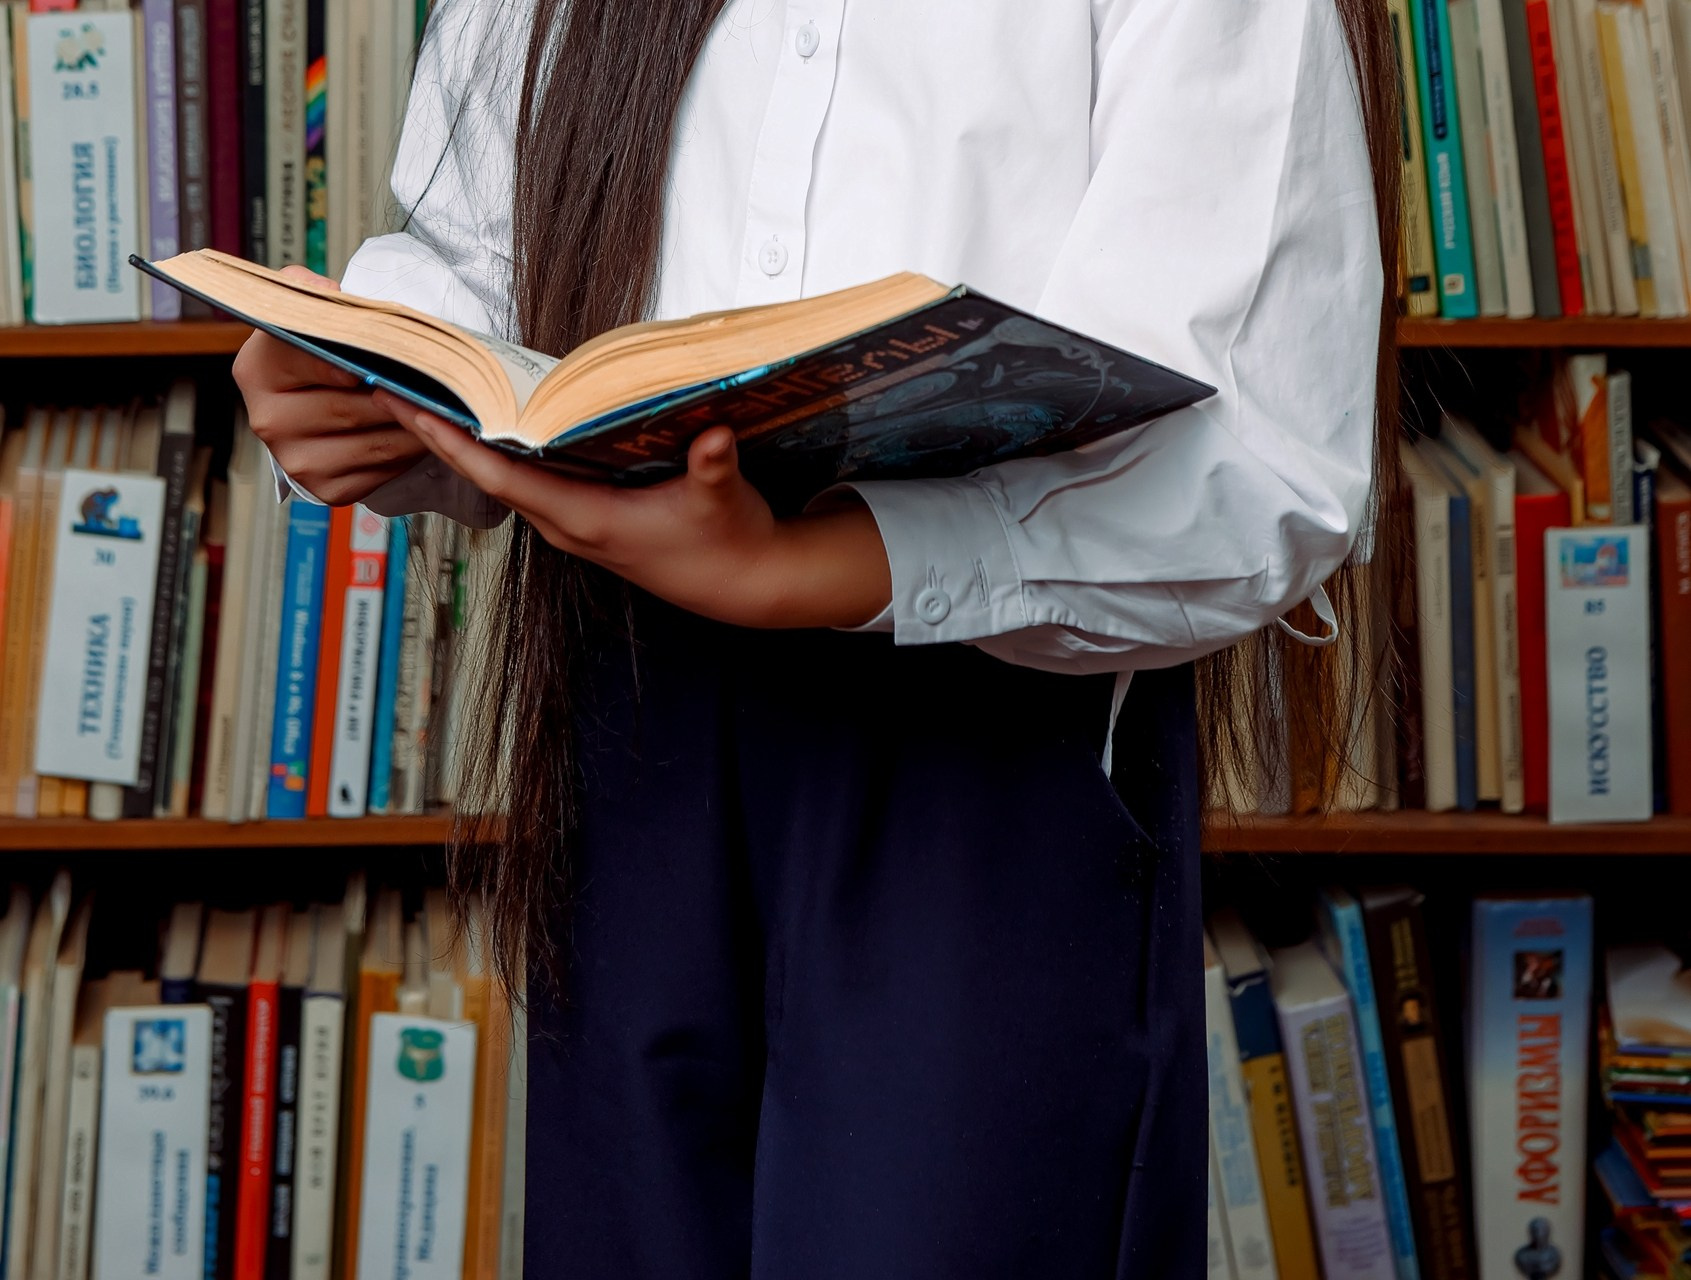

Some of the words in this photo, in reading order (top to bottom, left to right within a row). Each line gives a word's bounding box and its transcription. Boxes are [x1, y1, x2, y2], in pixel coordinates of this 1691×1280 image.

[73, 142, 97, 291] БИОЛОГИЯ
[76, 612, 110, 738] ТЕХНИКА
[1584, 645, 1610, 798] ИСКУССТВО
[1514, 1012, 1565, 1206] АФОРИЗМЫ
